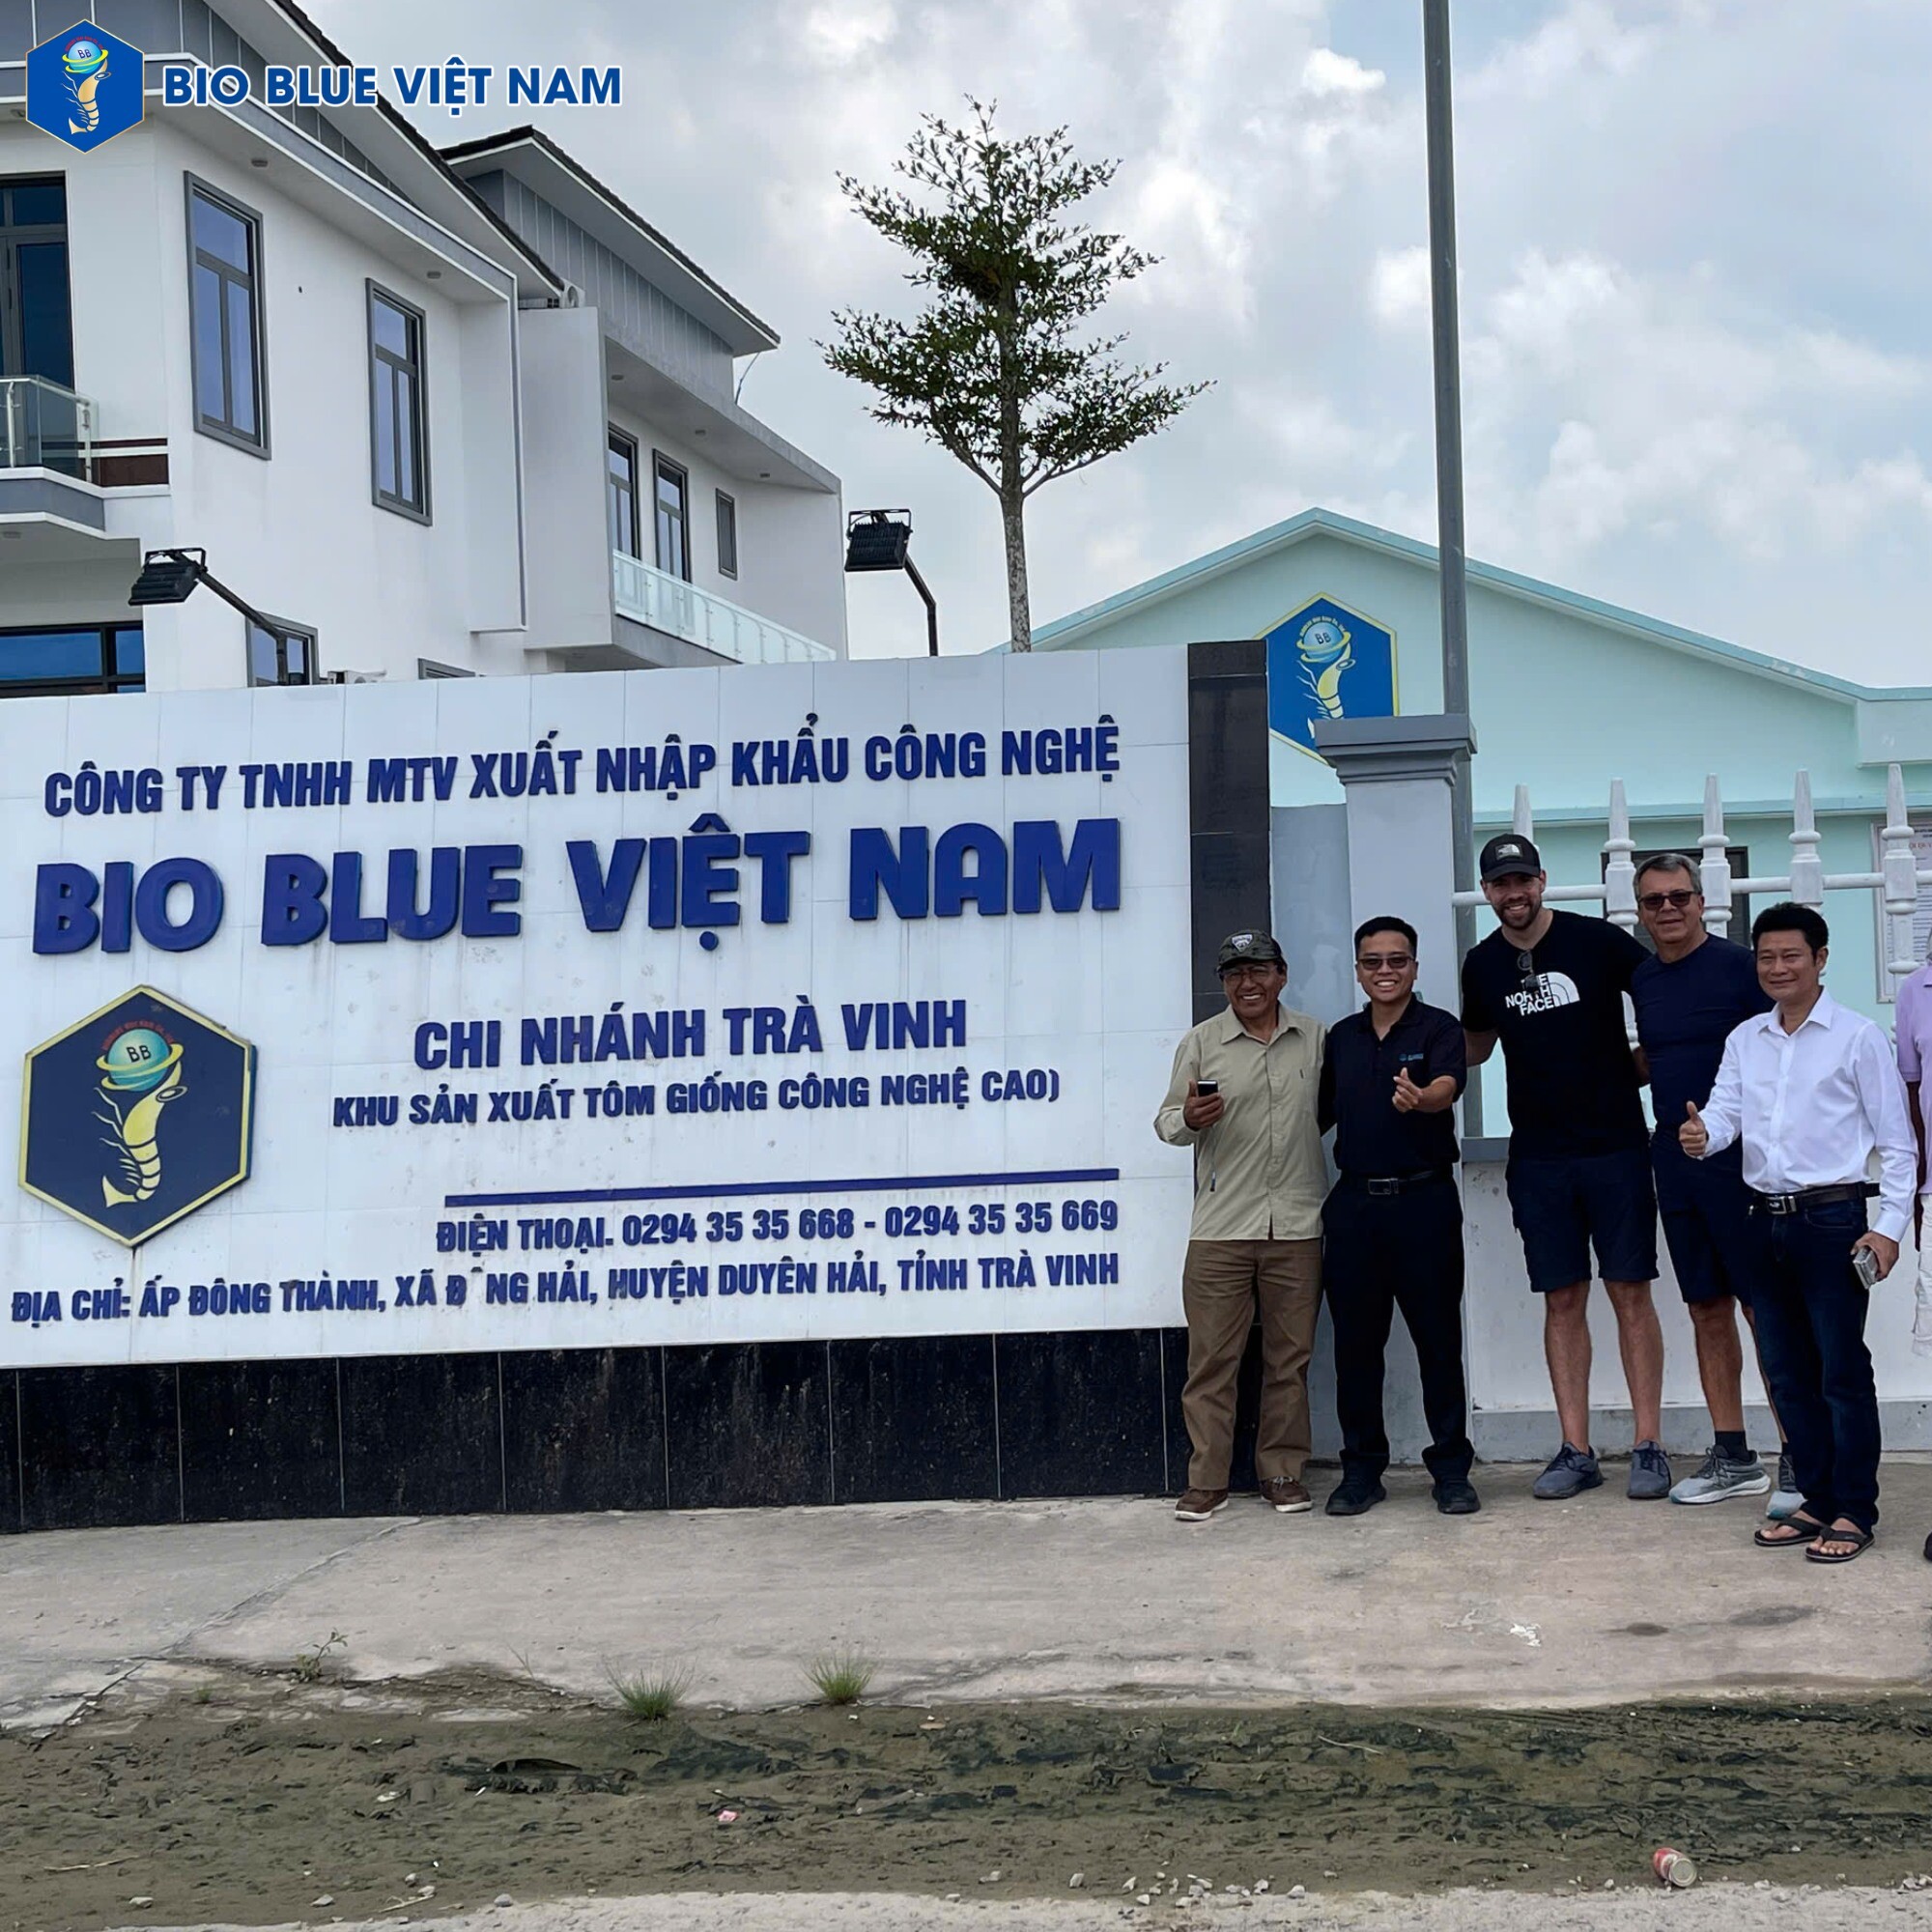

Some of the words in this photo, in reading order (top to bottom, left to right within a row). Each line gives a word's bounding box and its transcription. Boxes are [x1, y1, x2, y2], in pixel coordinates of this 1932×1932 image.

[45, 761, 163, 817] CÔNG
[176, 766, 227, 810] TY
[239, 761, 353, 809] TNHH
[367, 756, 458, 803] MTV
[469, 730, 582, 799] XUẤT
[596, 734, 716, 801] NHẬP
[732, 713, 849, 786] KHẨU
[865, 724, 986, 781] CÔNG
[1002, 714, 1120, 782] NGHỆ
[33, 858, 225, 956] BIO
[261, 844, 525, 948] BLUE
[565, 813, 813, 952] VIỆT
[849, 818, 1122, 921] NAM
[414, 1020, 501, 1070] CHI
[521, 1002, 705, 1065] NHÁNH
[723, 995, 823, 1056] TRÀ
[841, 1000, 966, 1051] VINH
[1520, 996, 1554, 1016] FACE
[126, 1044, 152, 1063] BB
[333, 1095, 399, 1127] KHU
[409, 1084, 477, 1124] SẢN
[488, 1079, 575, 1122] XUẤT
[583, 1080, 655, 1118] TÔM
[667, 1071, 767, 1114] GIỐNG
[779, 1072, 869, 1109] CÔNG
[881, 1066, 969, 1110] NGHỆ
[981, 1069, 1059, 1102] CAO)
[436, 1213, 508, 1257] ĐIỆN
[622, 1213, 696, 1246] 0294
[706, 1211, 743, 1242] 35
[753, 1209, 789, 1239] 35
[799, 1208, 854, 1239] 668
[885, 1206, 959, 1237] 0294
[969, 1204, 1005, 1235] 35
[1015, 1203, 1052, 1233] 35
[1062, 1200, 1118, 1231] 669
[12, 1292, 62, 1328] ĐỊA
[71, 1278, 130, 1321] CHỈ:
[139, 1275, 180, 1318] ẤP
[188, 1278, 270, 1316] ĐÔNG
[279, 1270, 385, 1312] THÀNH,
[394, 1268, 437, 1307] XÃ
[445, 1266, 528, 1307] ĐNG
[538, 1260, 597, 1305] HẢI,
[609, 1260, 708, 1304] HUYỆN
[719, 1256, 817, 1295] DUYÊN
[827, 1250, 886, 1296] HẢI,
[897, 1249, 967, 1291] TỈNH
[978, 1249, 1036, 1289] TRÀ
[1045, 1253, 1119, 1286] VINH
